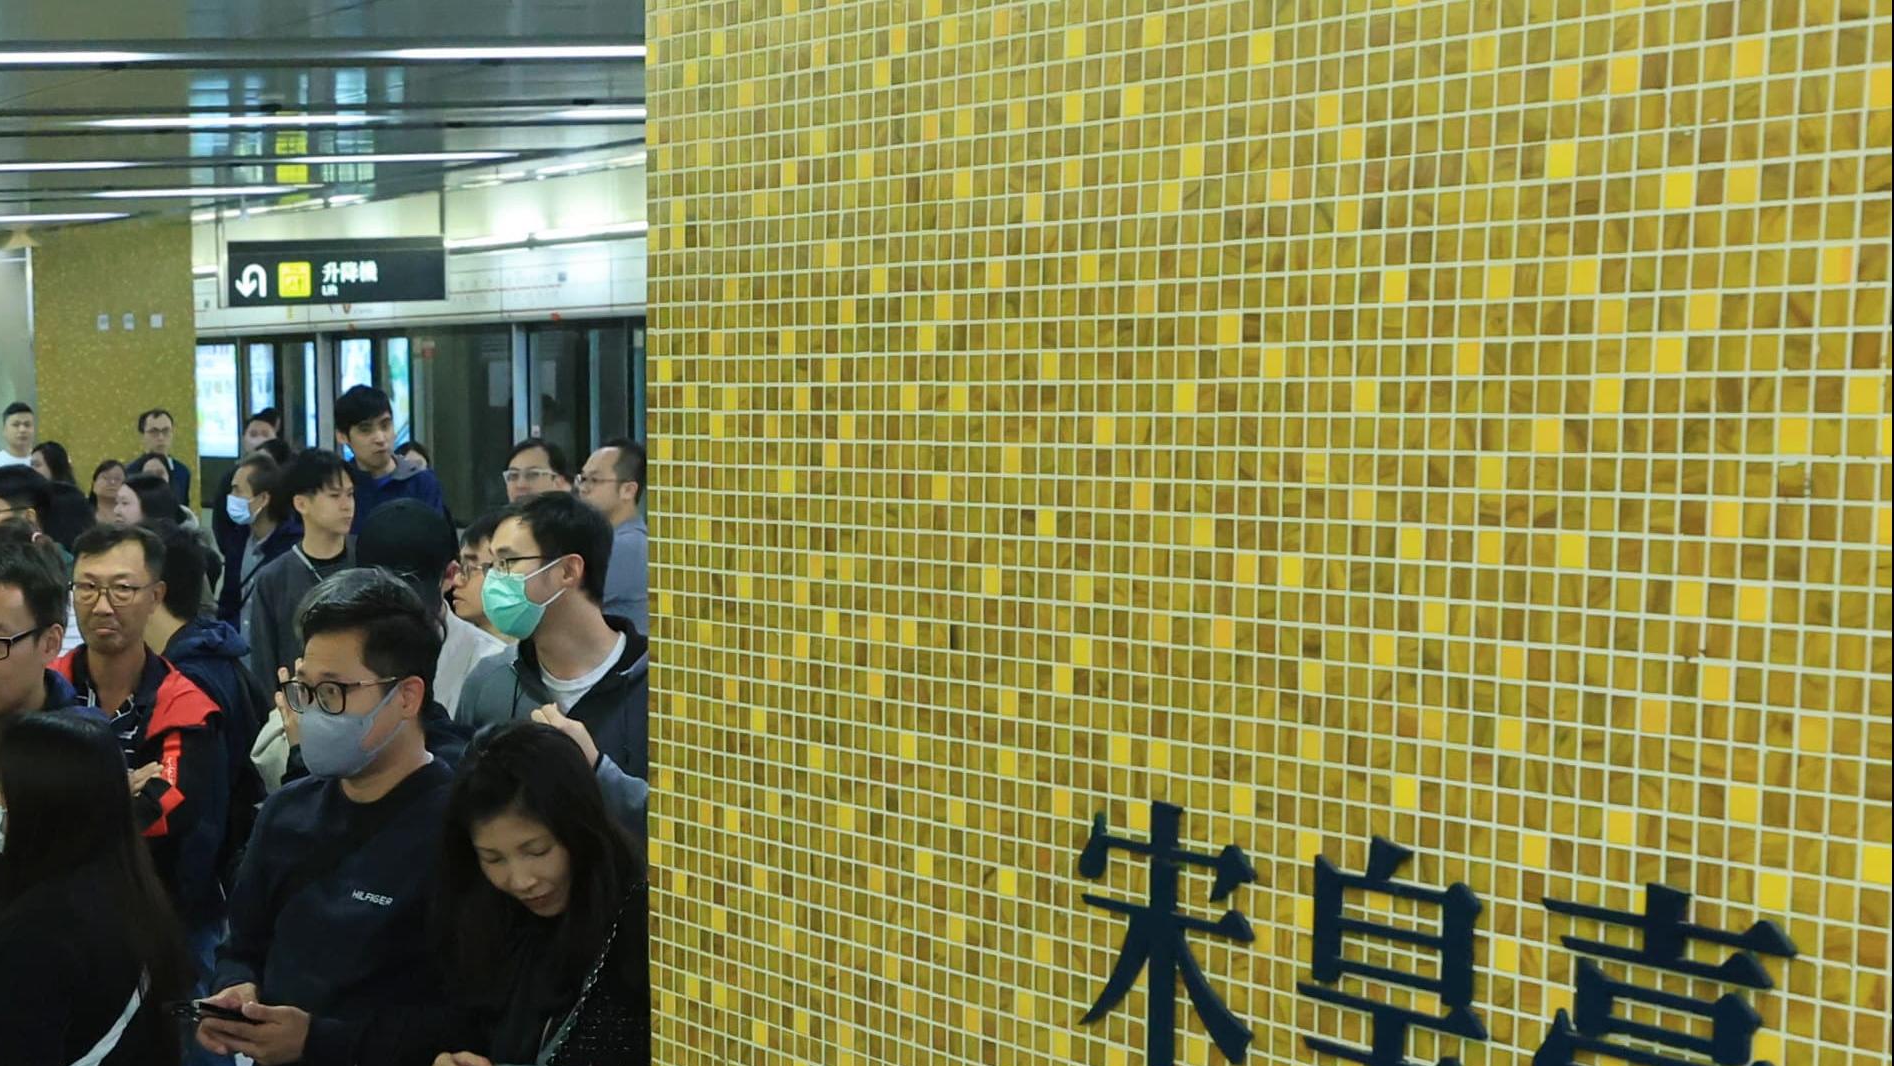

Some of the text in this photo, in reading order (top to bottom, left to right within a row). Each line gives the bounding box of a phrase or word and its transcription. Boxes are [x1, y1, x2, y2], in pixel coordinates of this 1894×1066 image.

[321, 260, 378, 283] 升降機
[352, 889, 394, 905] HILFIGER
